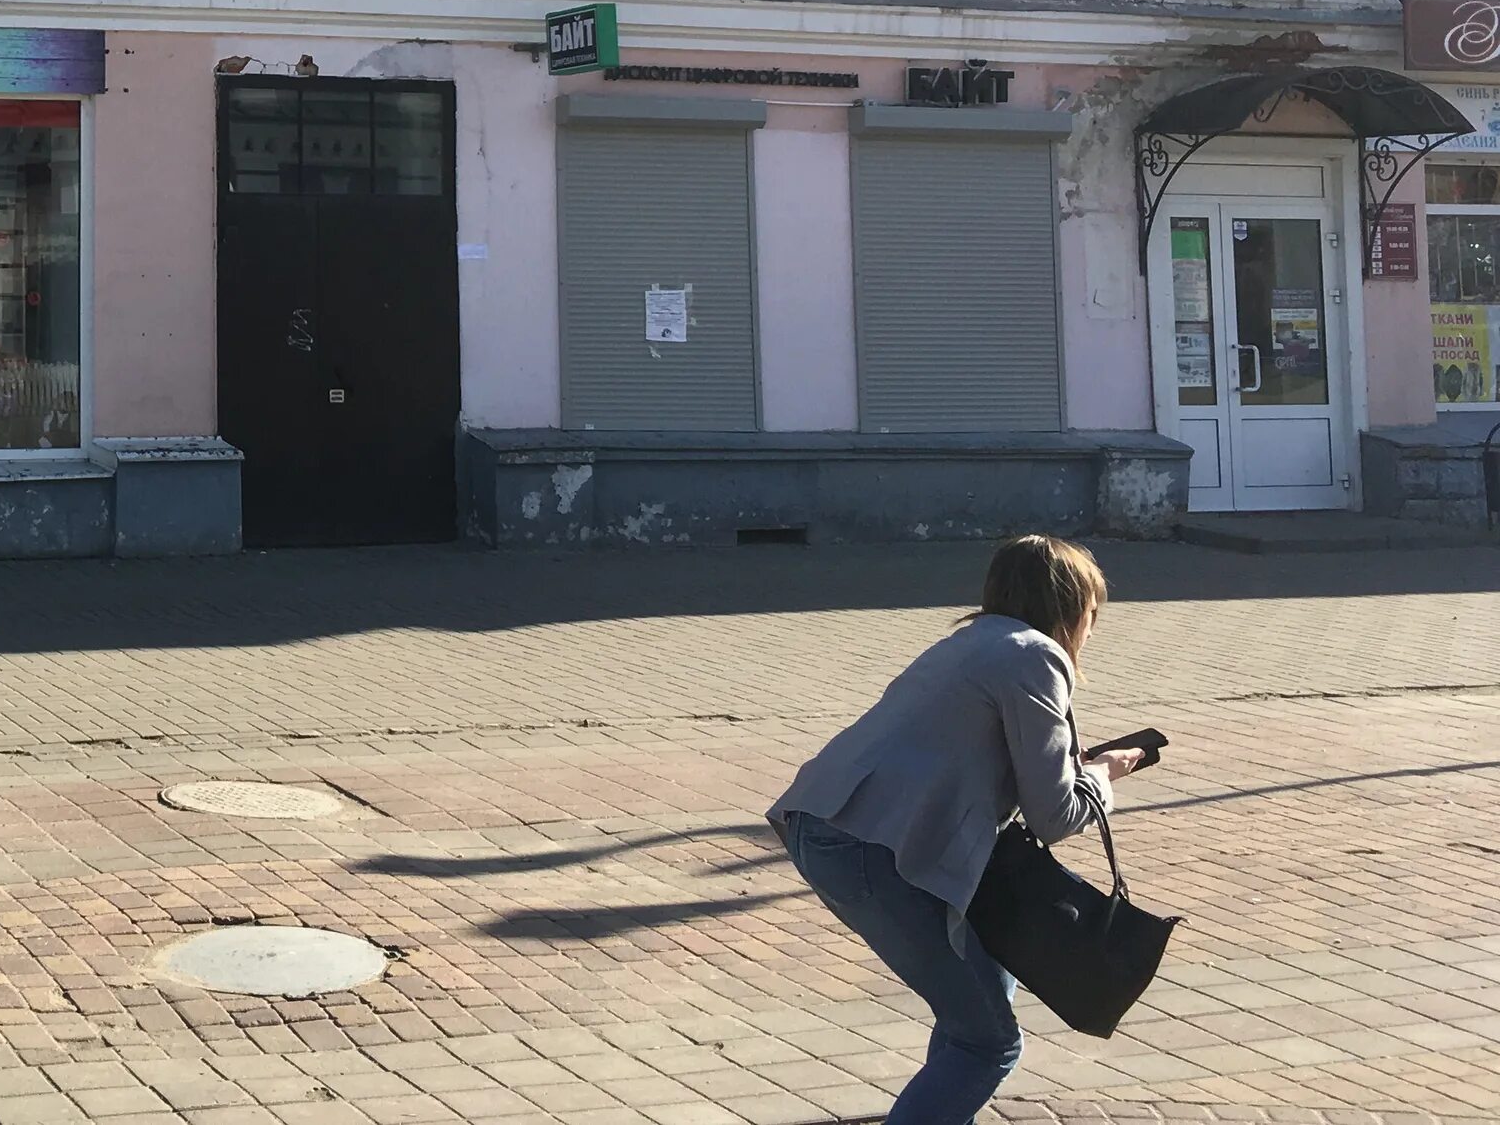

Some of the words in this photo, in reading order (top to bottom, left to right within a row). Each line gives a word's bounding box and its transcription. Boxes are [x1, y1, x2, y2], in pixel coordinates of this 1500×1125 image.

[550, 14, 595, 53] БАЙТ
[604, 65, 683, 81] ДИСКОНТ
[685, 67, 782, 85] ЦИФРОВОЙ
[905, 59, 1016, 107] БАЙТ
[1456, 86, 1490, 100] СИНЬ
[1430, 313, 1474, 325] ТКАНИ
